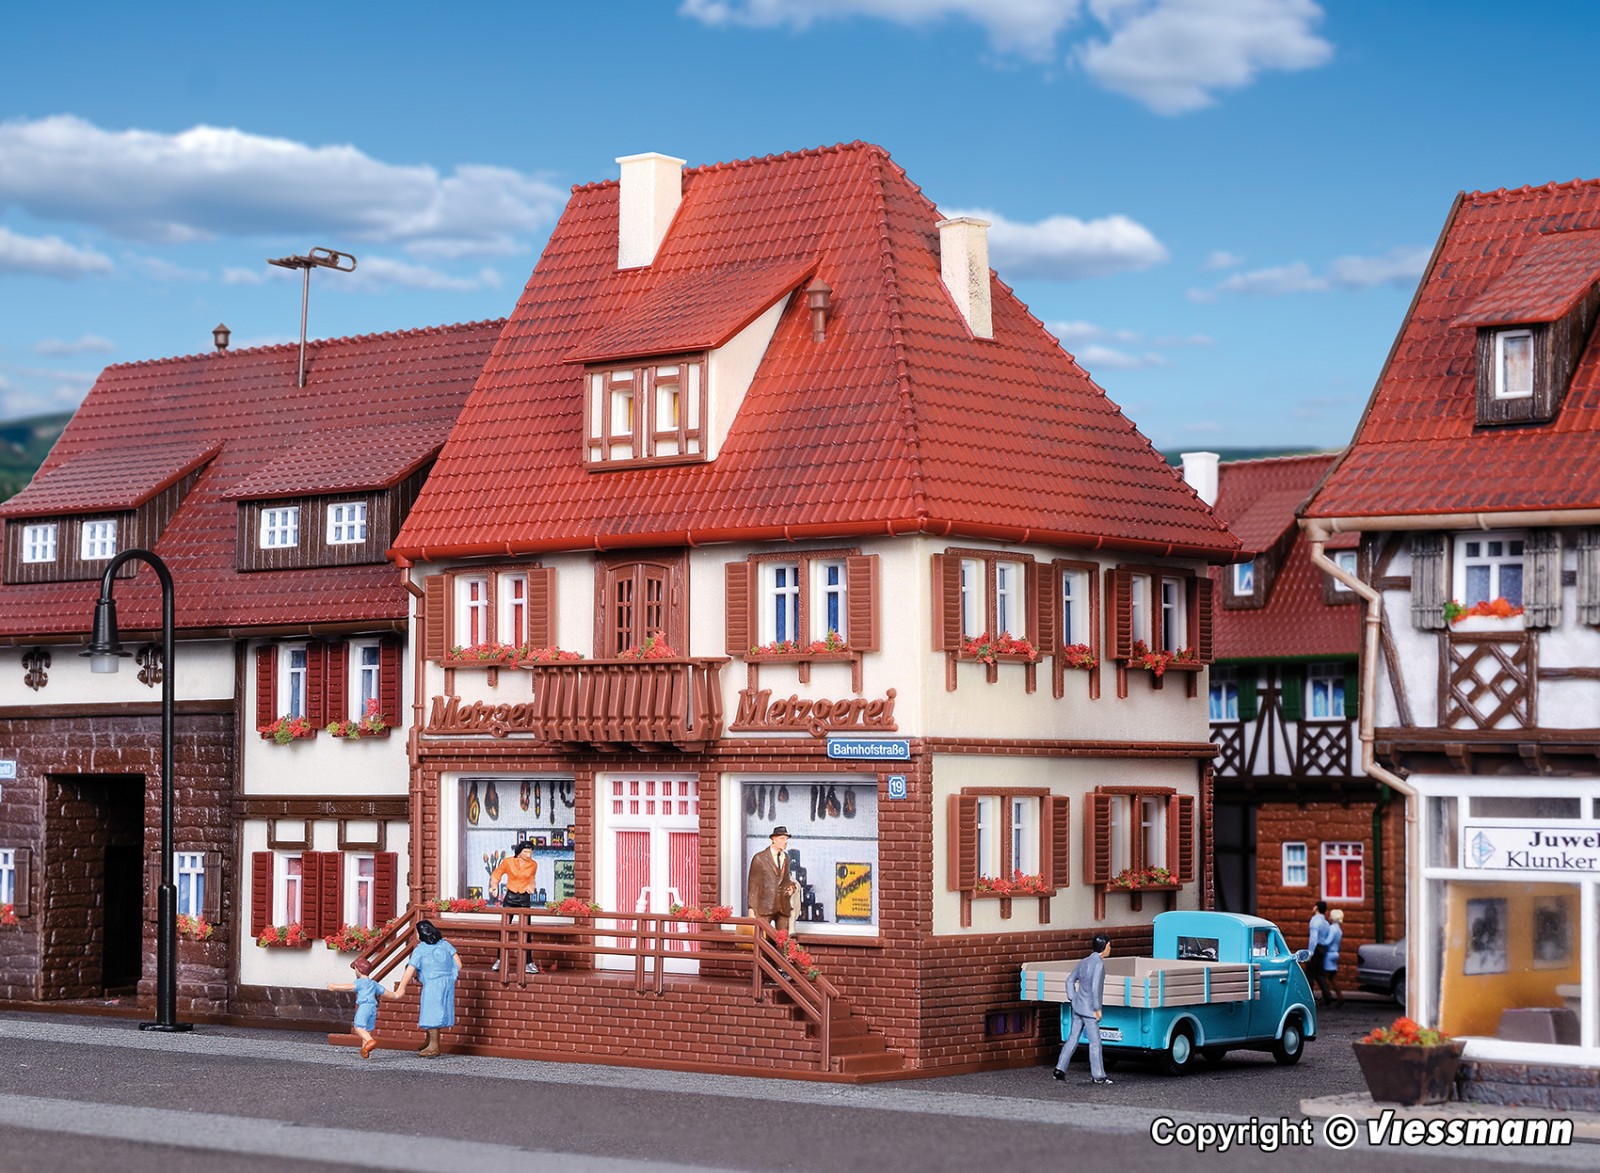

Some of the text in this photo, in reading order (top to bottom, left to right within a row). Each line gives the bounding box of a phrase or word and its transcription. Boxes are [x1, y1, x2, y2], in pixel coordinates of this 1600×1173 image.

[732, 688, 898, 738] Metzgerei
[833, 743, 905, 756] Bahnhofstraße
[890, 780, 903, 794] 19
[1506, 851, 1597, 870] Klunker
